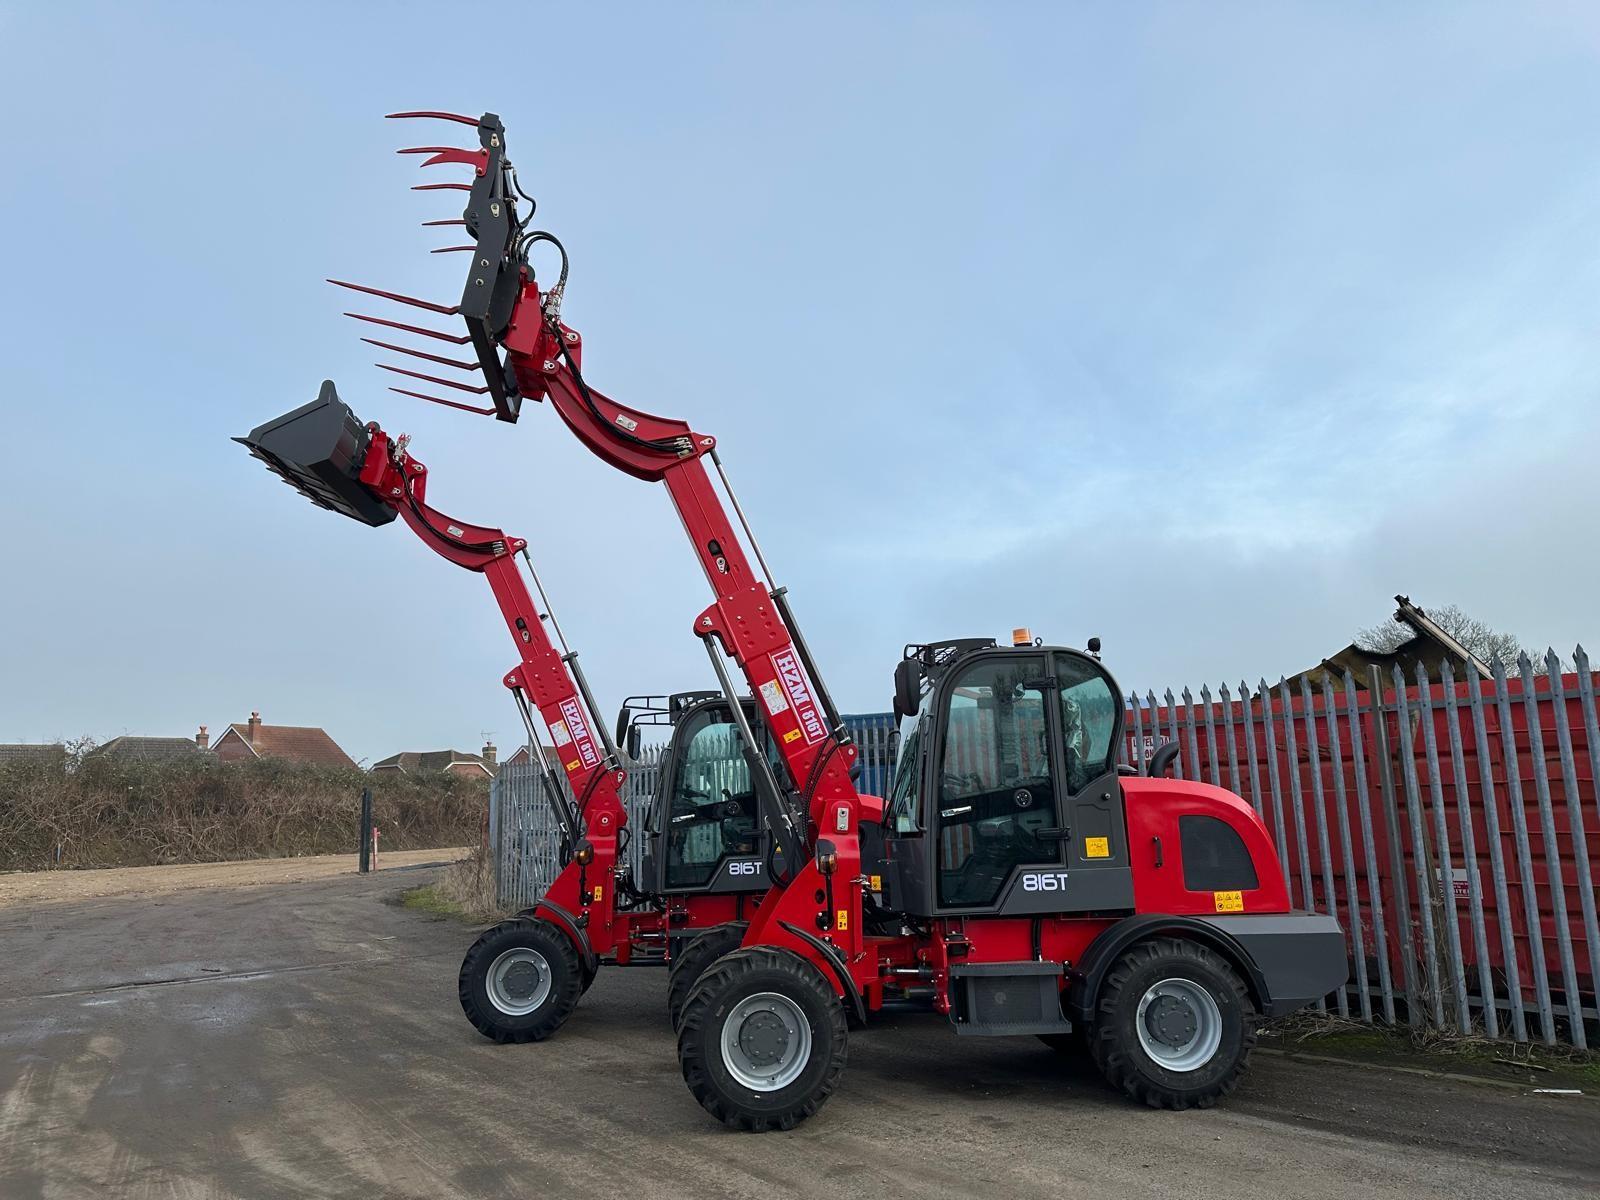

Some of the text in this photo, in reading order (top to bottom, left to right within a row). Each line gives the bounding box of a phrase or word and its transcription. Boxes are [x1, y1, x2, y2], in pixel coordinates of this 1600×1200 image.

[777, 655, 823, 738] HZM 816T
[562, 701, 597, 764] HZM 816T
[729, 862, 762, 875] 816T
[1022, 873, 1068, 891] 816T
